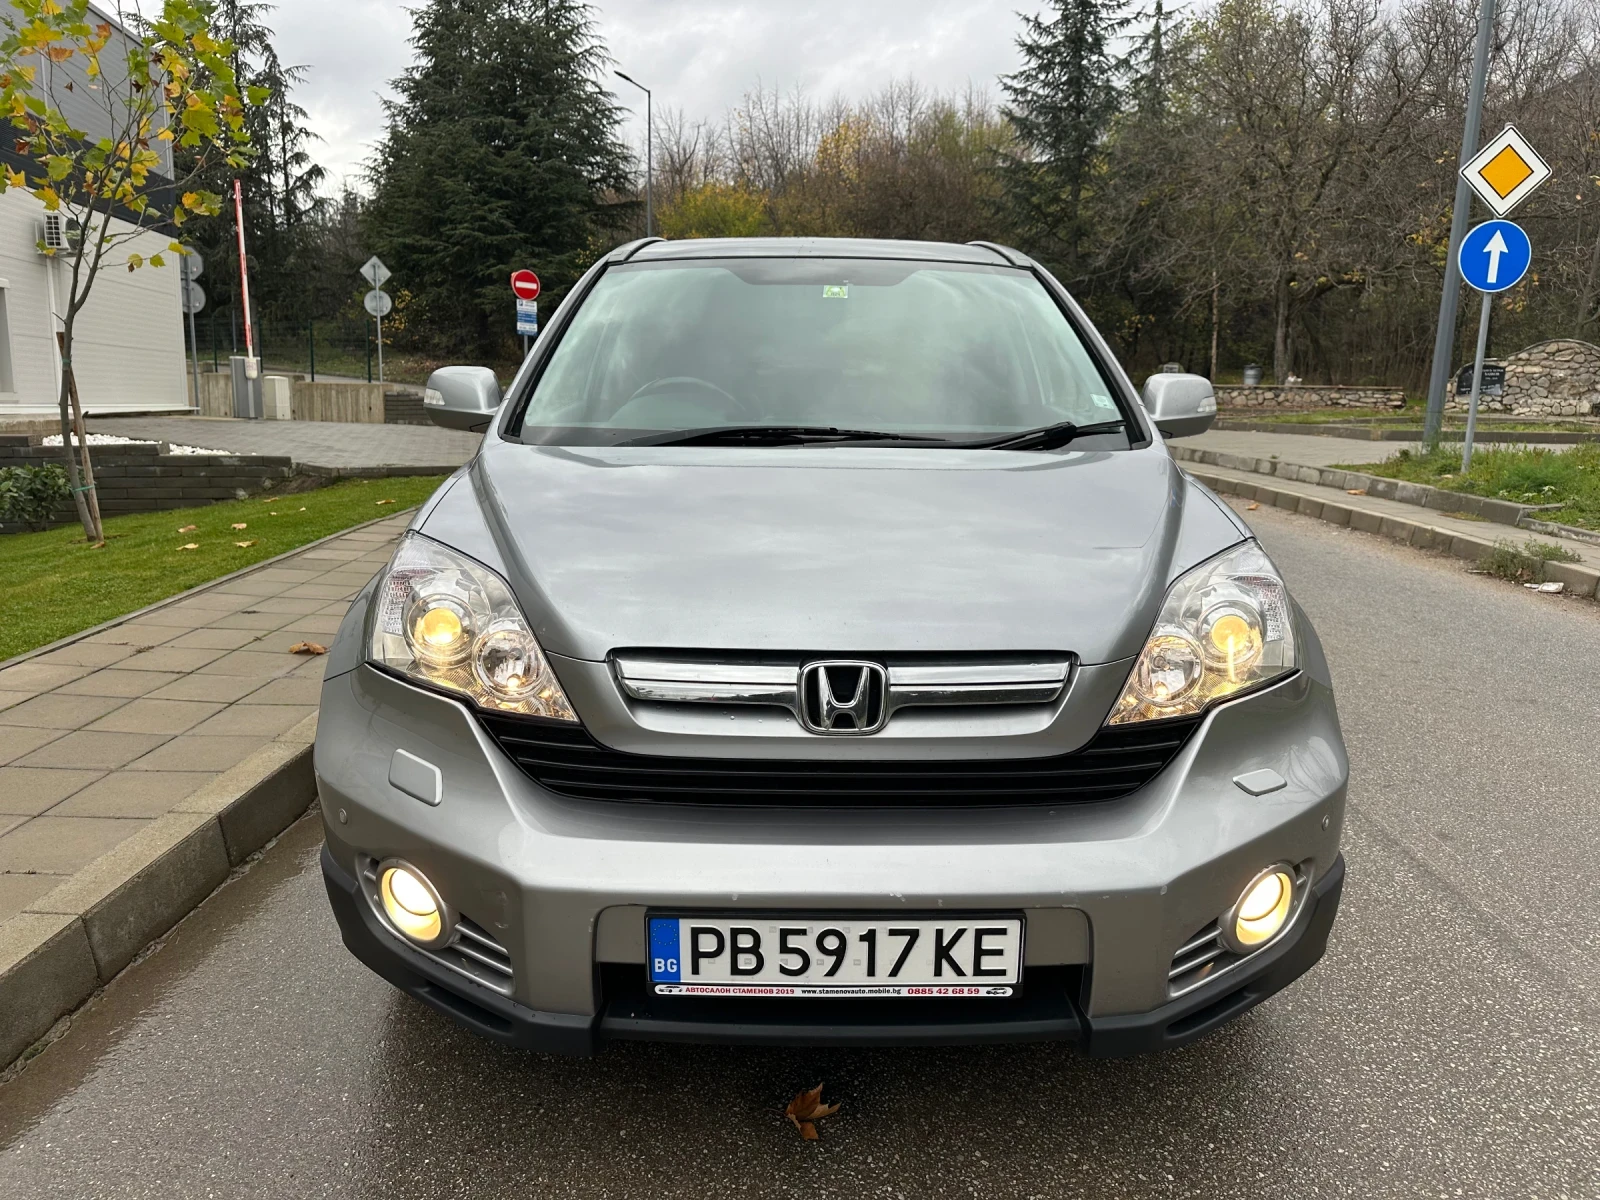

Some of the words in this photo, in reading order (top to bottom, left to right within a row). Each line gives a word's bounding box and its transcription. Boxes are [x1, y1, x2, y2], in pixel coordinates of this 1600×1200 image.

[690, 926, 765, 976] PB
[779, 926, 920, 978] 5917
[933, 926, 1008, 977] KE
[654, 958, 678, 973] BG
[685, 986, 731, 994] АВТОСАЛОН
[732, 987, 774, 995] СТАМЕНОВ
[775, 987, 795, 995] 2019
[801, 987, 902, 996] www.stamenovauto.mobile.bg
[907, 987, 934, 995] 0885
[935, 987, 949, 995] 42
[951, 987, 965, 995] 68
[966, 987, 980, 995] 59
